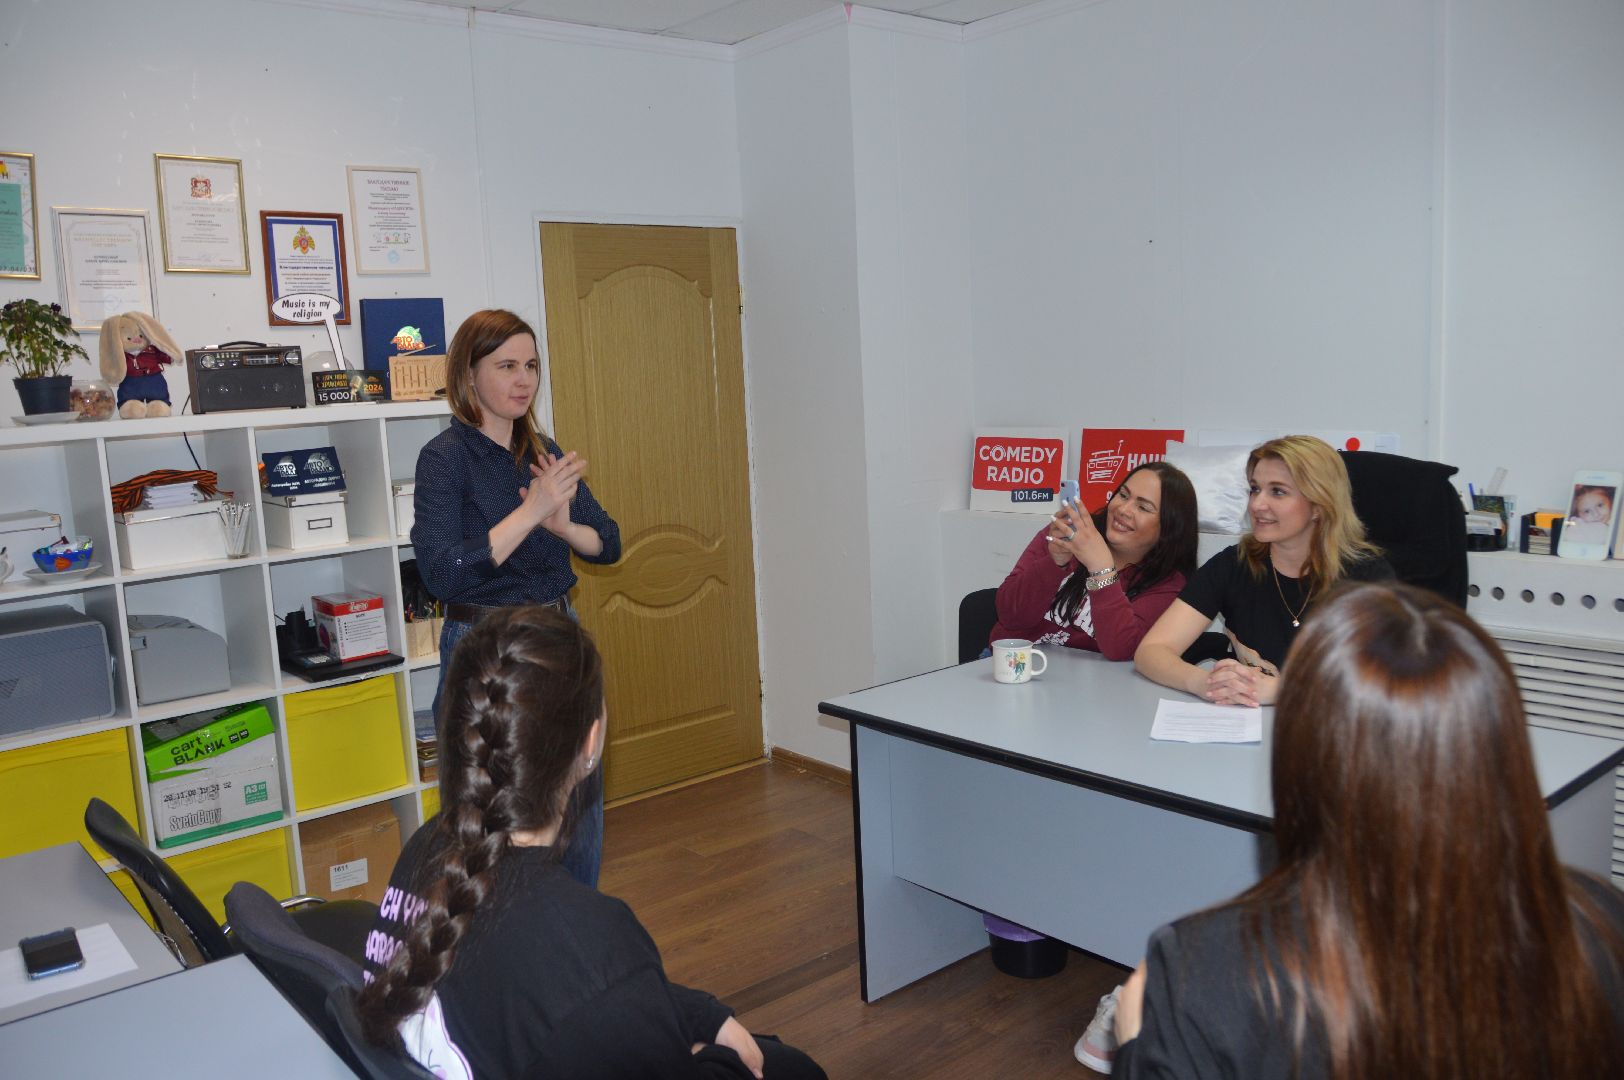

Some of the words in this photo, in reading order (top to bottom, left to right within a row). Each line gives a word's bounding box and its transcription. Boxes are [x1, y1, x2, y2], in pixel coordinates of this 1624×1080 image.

[281, 299, 306, 308] Music
[309, 299, 316, 307] is
[319, 301, 331, 309] my
[292, 309, 323, 320] religion
[318, 392, 328, 401] 15
[330, 391, 350, 400] 000
[363, 383, 384, 391] 2024
[979, 445, 1058, 463] COMEDY
[987, 466, 1044, 484] RADIO
[170, 736, 203, 755] cart
[173, 739, 225, 766] BLANK
[169, 807, 222, 832] SvetoCopy
